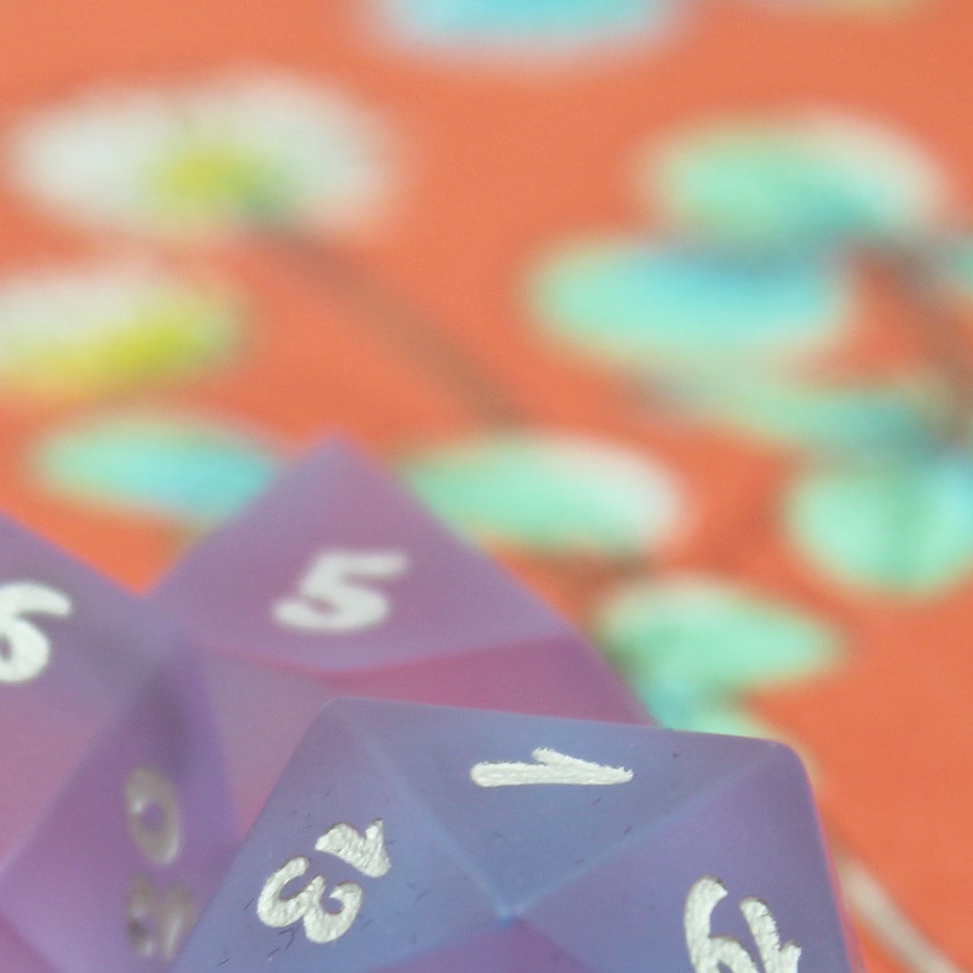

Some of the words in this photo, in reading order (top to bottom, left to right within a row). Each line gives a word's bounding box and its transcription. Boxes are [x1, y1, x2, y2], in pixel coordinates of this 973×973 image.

[273, 552, 407, 631] 5
[470, 747, 633, 787] 1
[256, 819, 392, 944] 13
